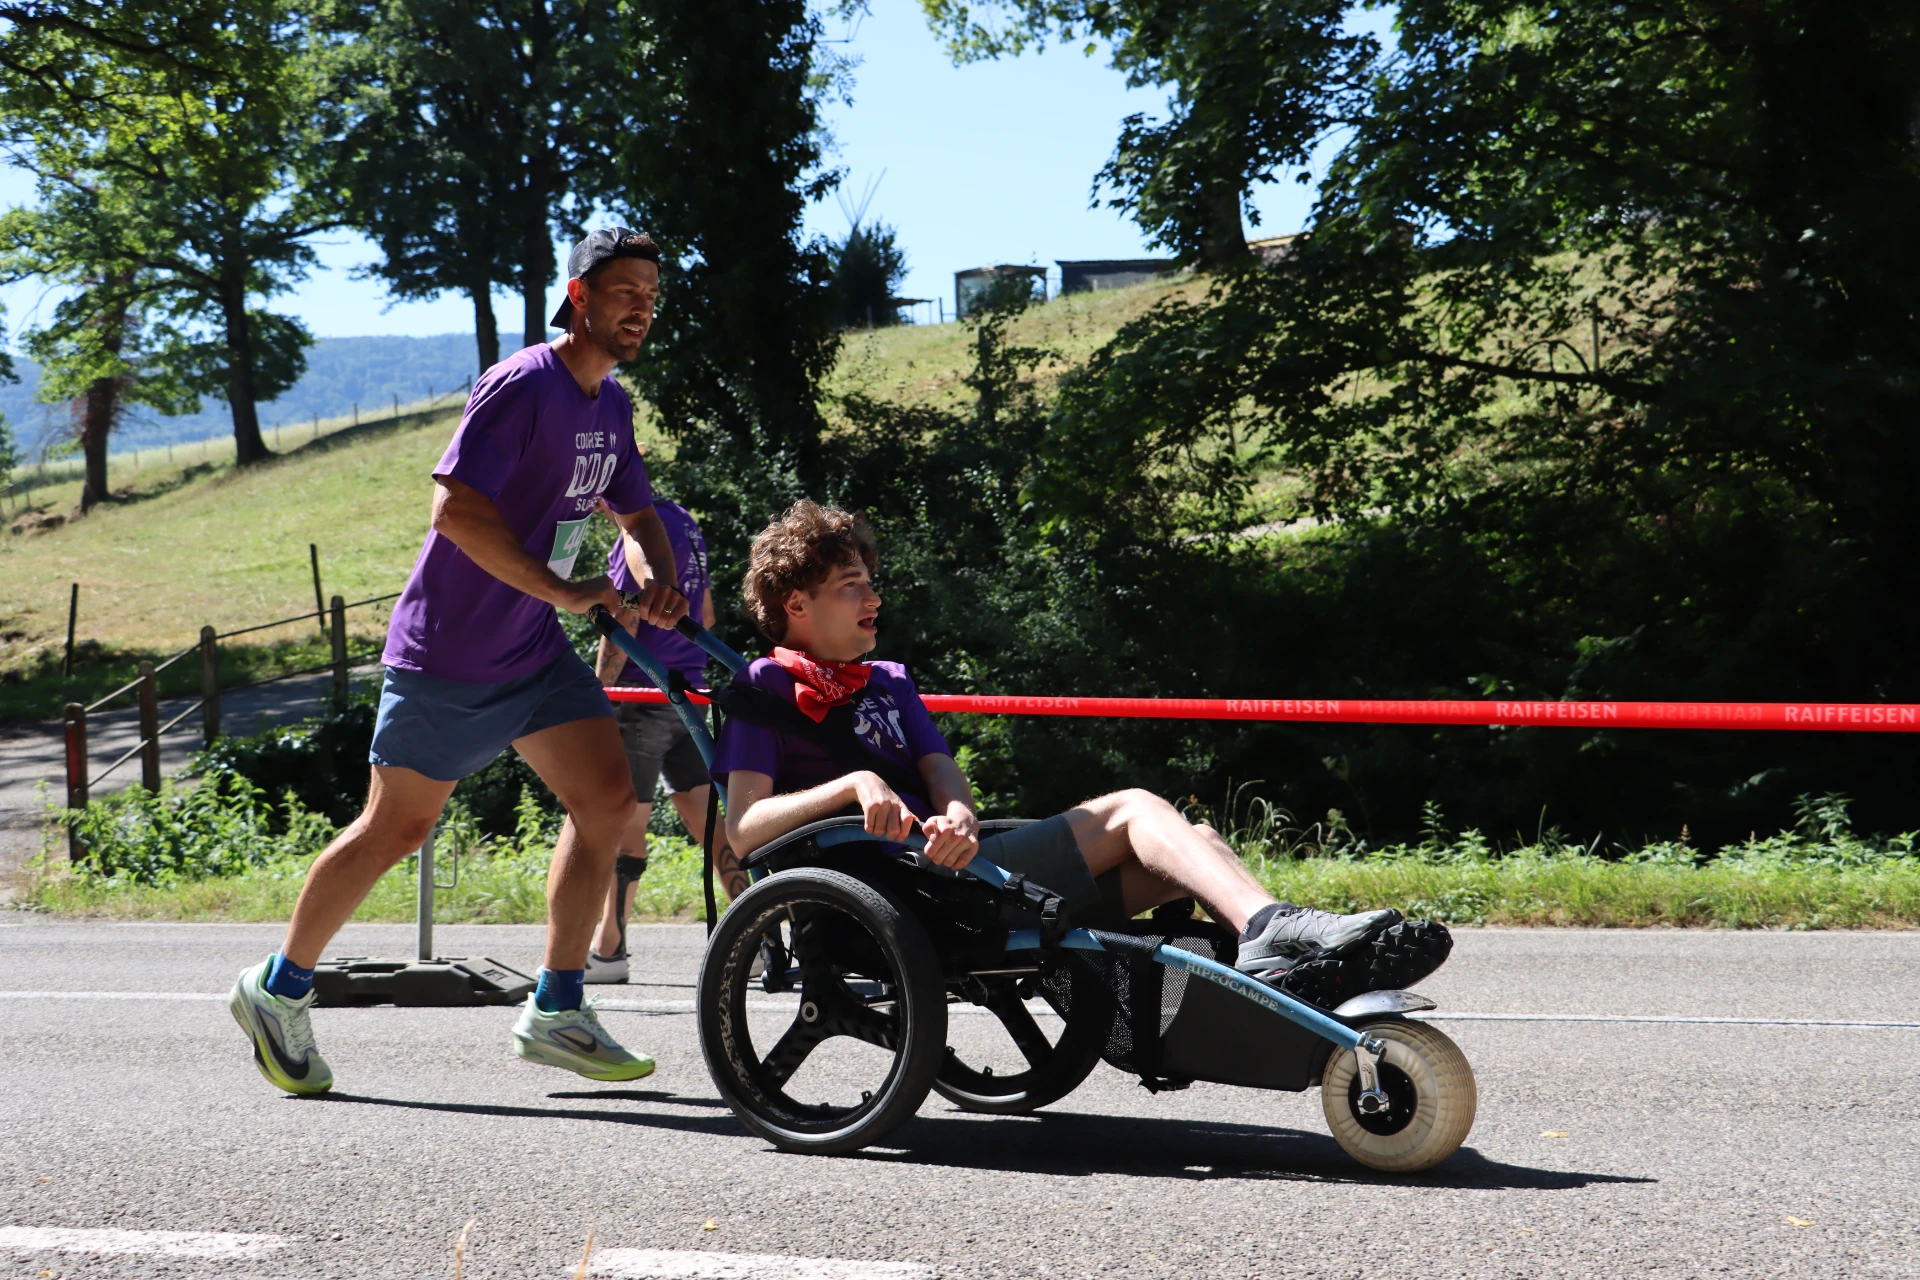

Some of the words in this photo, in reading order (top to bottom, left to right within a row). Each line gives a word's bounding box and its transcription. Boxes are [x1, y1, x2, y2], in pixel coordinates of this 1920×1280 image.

[564, 453, 617, 498] DUO
[1225, 699, 1340, 714] RAIFFEISEN
[1496, 702, 1617, 719] RAIFFEISEN
[1784, 706, 1916, 724] RAIFFEISEN
[1184, 960, 1280, 1012] HIPPOCAMPE
